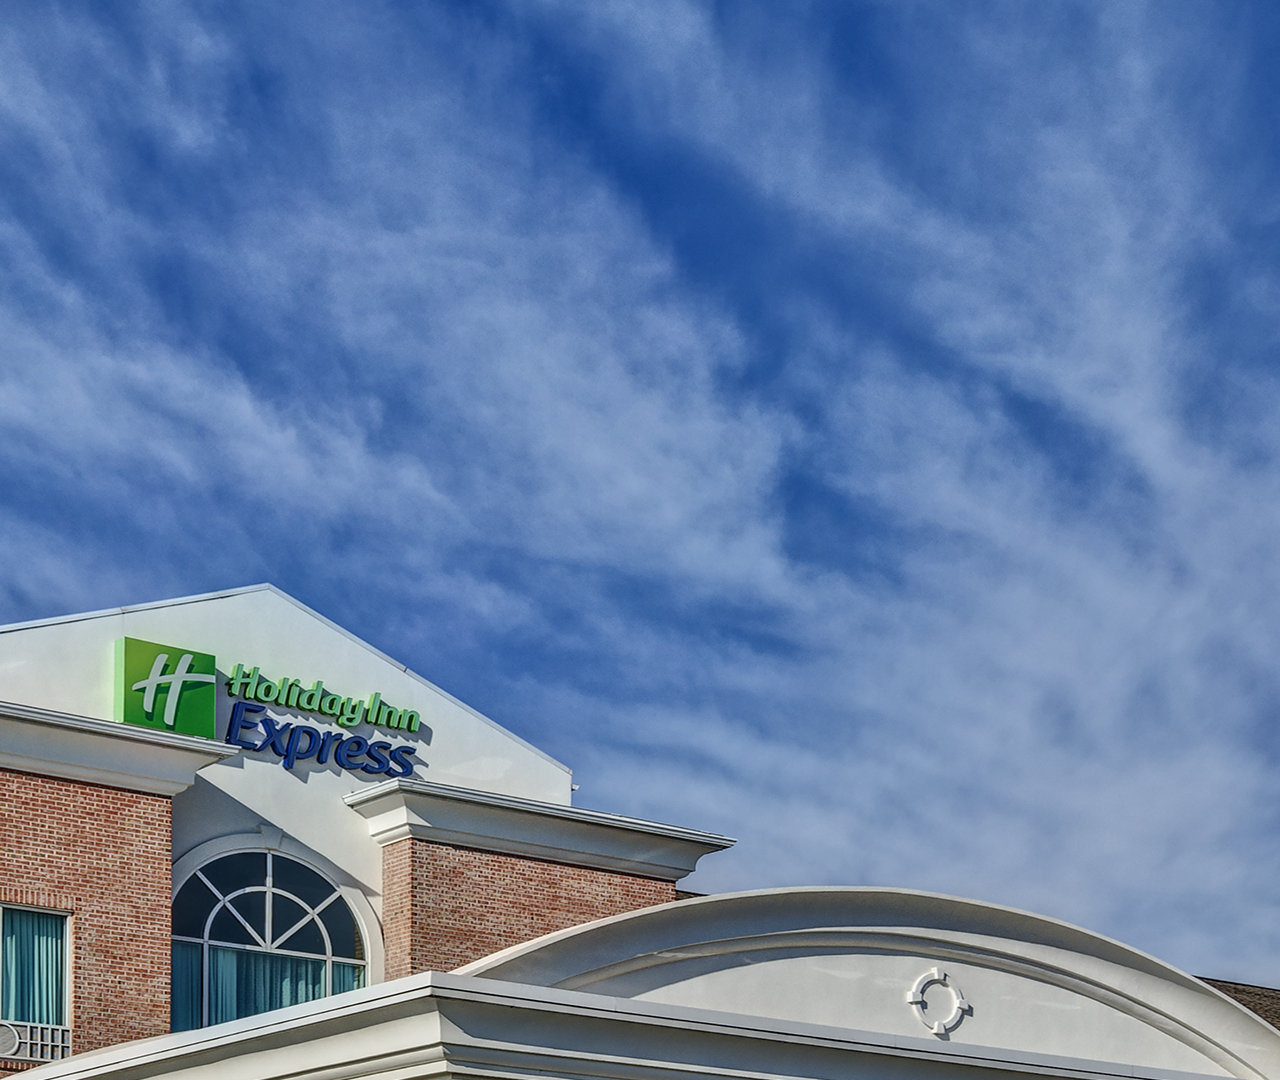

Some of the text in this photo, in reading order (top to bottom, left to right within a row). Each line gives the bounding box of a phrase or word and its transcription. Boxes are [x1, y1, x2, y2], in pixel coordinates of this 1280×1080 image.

[228, 663, 421, 733] Holiday Inn
[225, 701, 417, 778] Express
